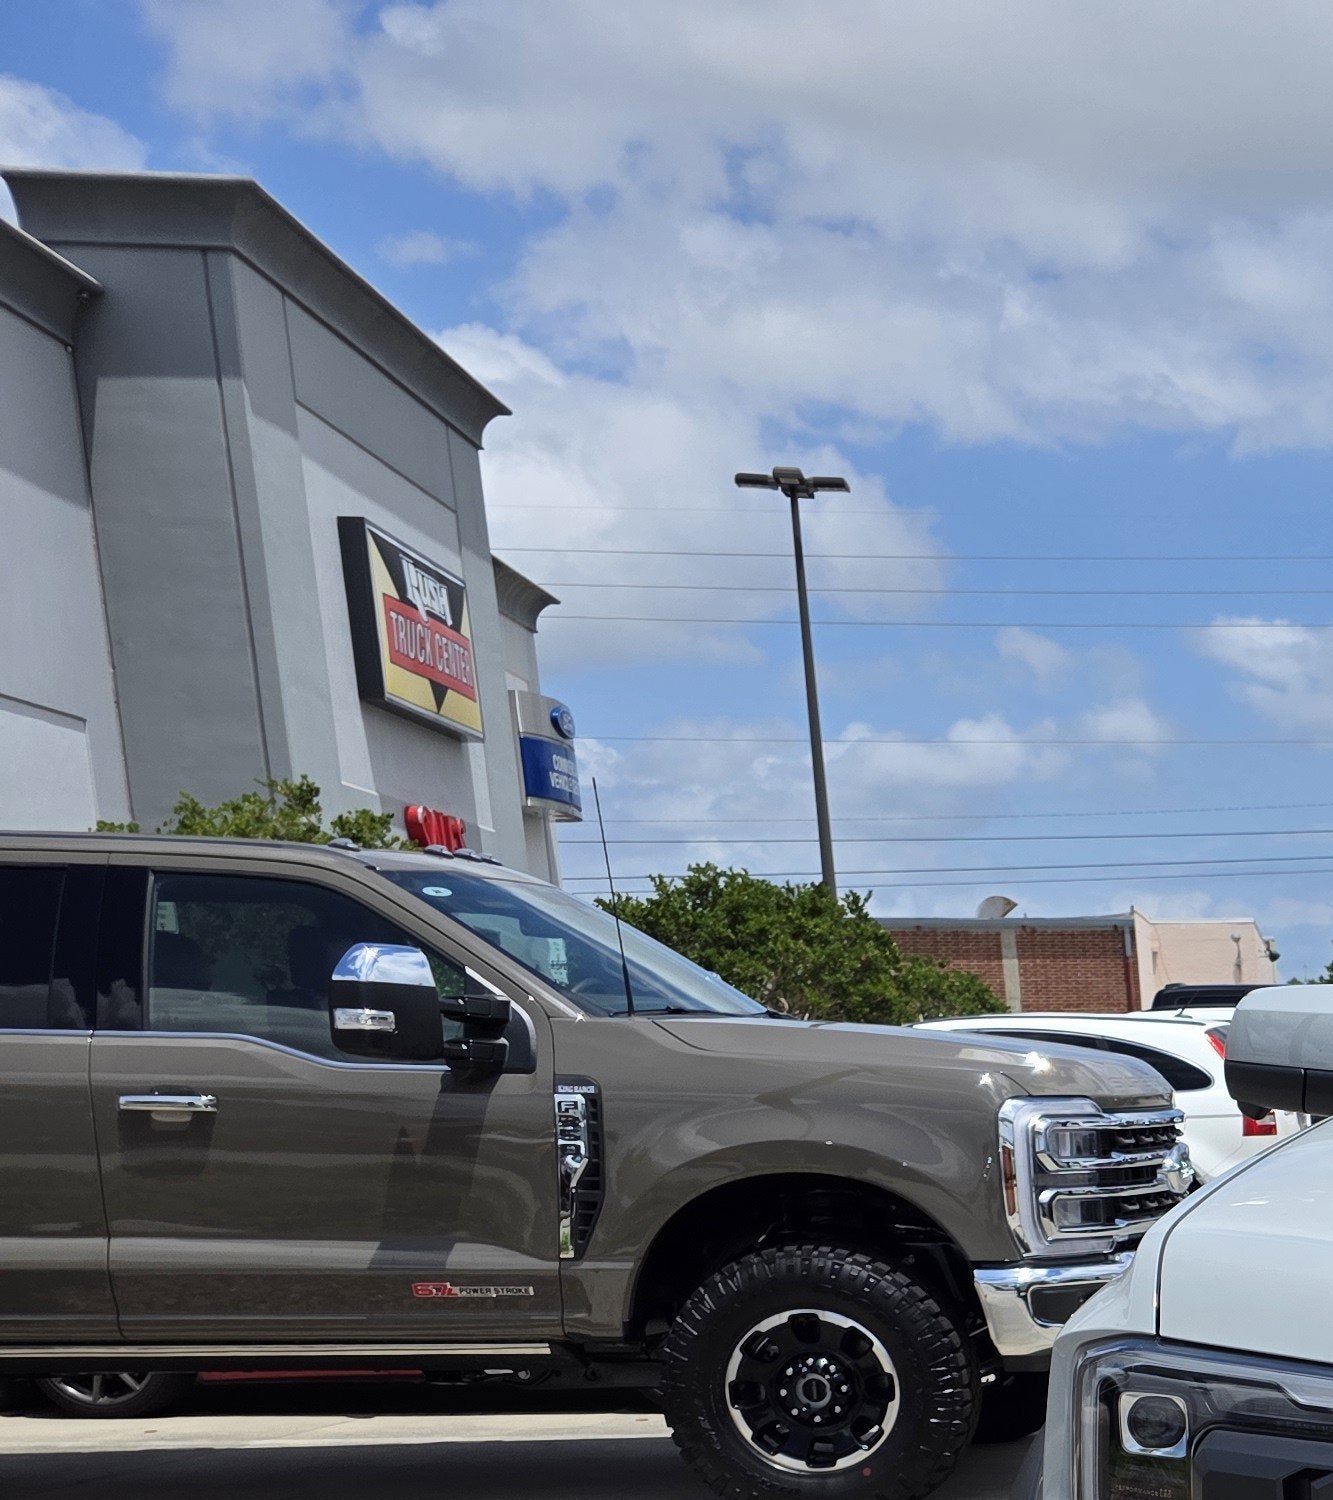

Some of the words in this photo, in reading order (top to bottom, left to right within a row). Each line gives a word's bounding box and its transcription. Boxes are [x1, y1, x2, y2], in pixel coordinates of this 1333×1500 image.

[389, 610, 434, 668] TRUCK
[434, 632, 476, 688] CENTER
[460, 1286, 491, 1295] POWER
[493, 1286, 529, 1295] STROKE
